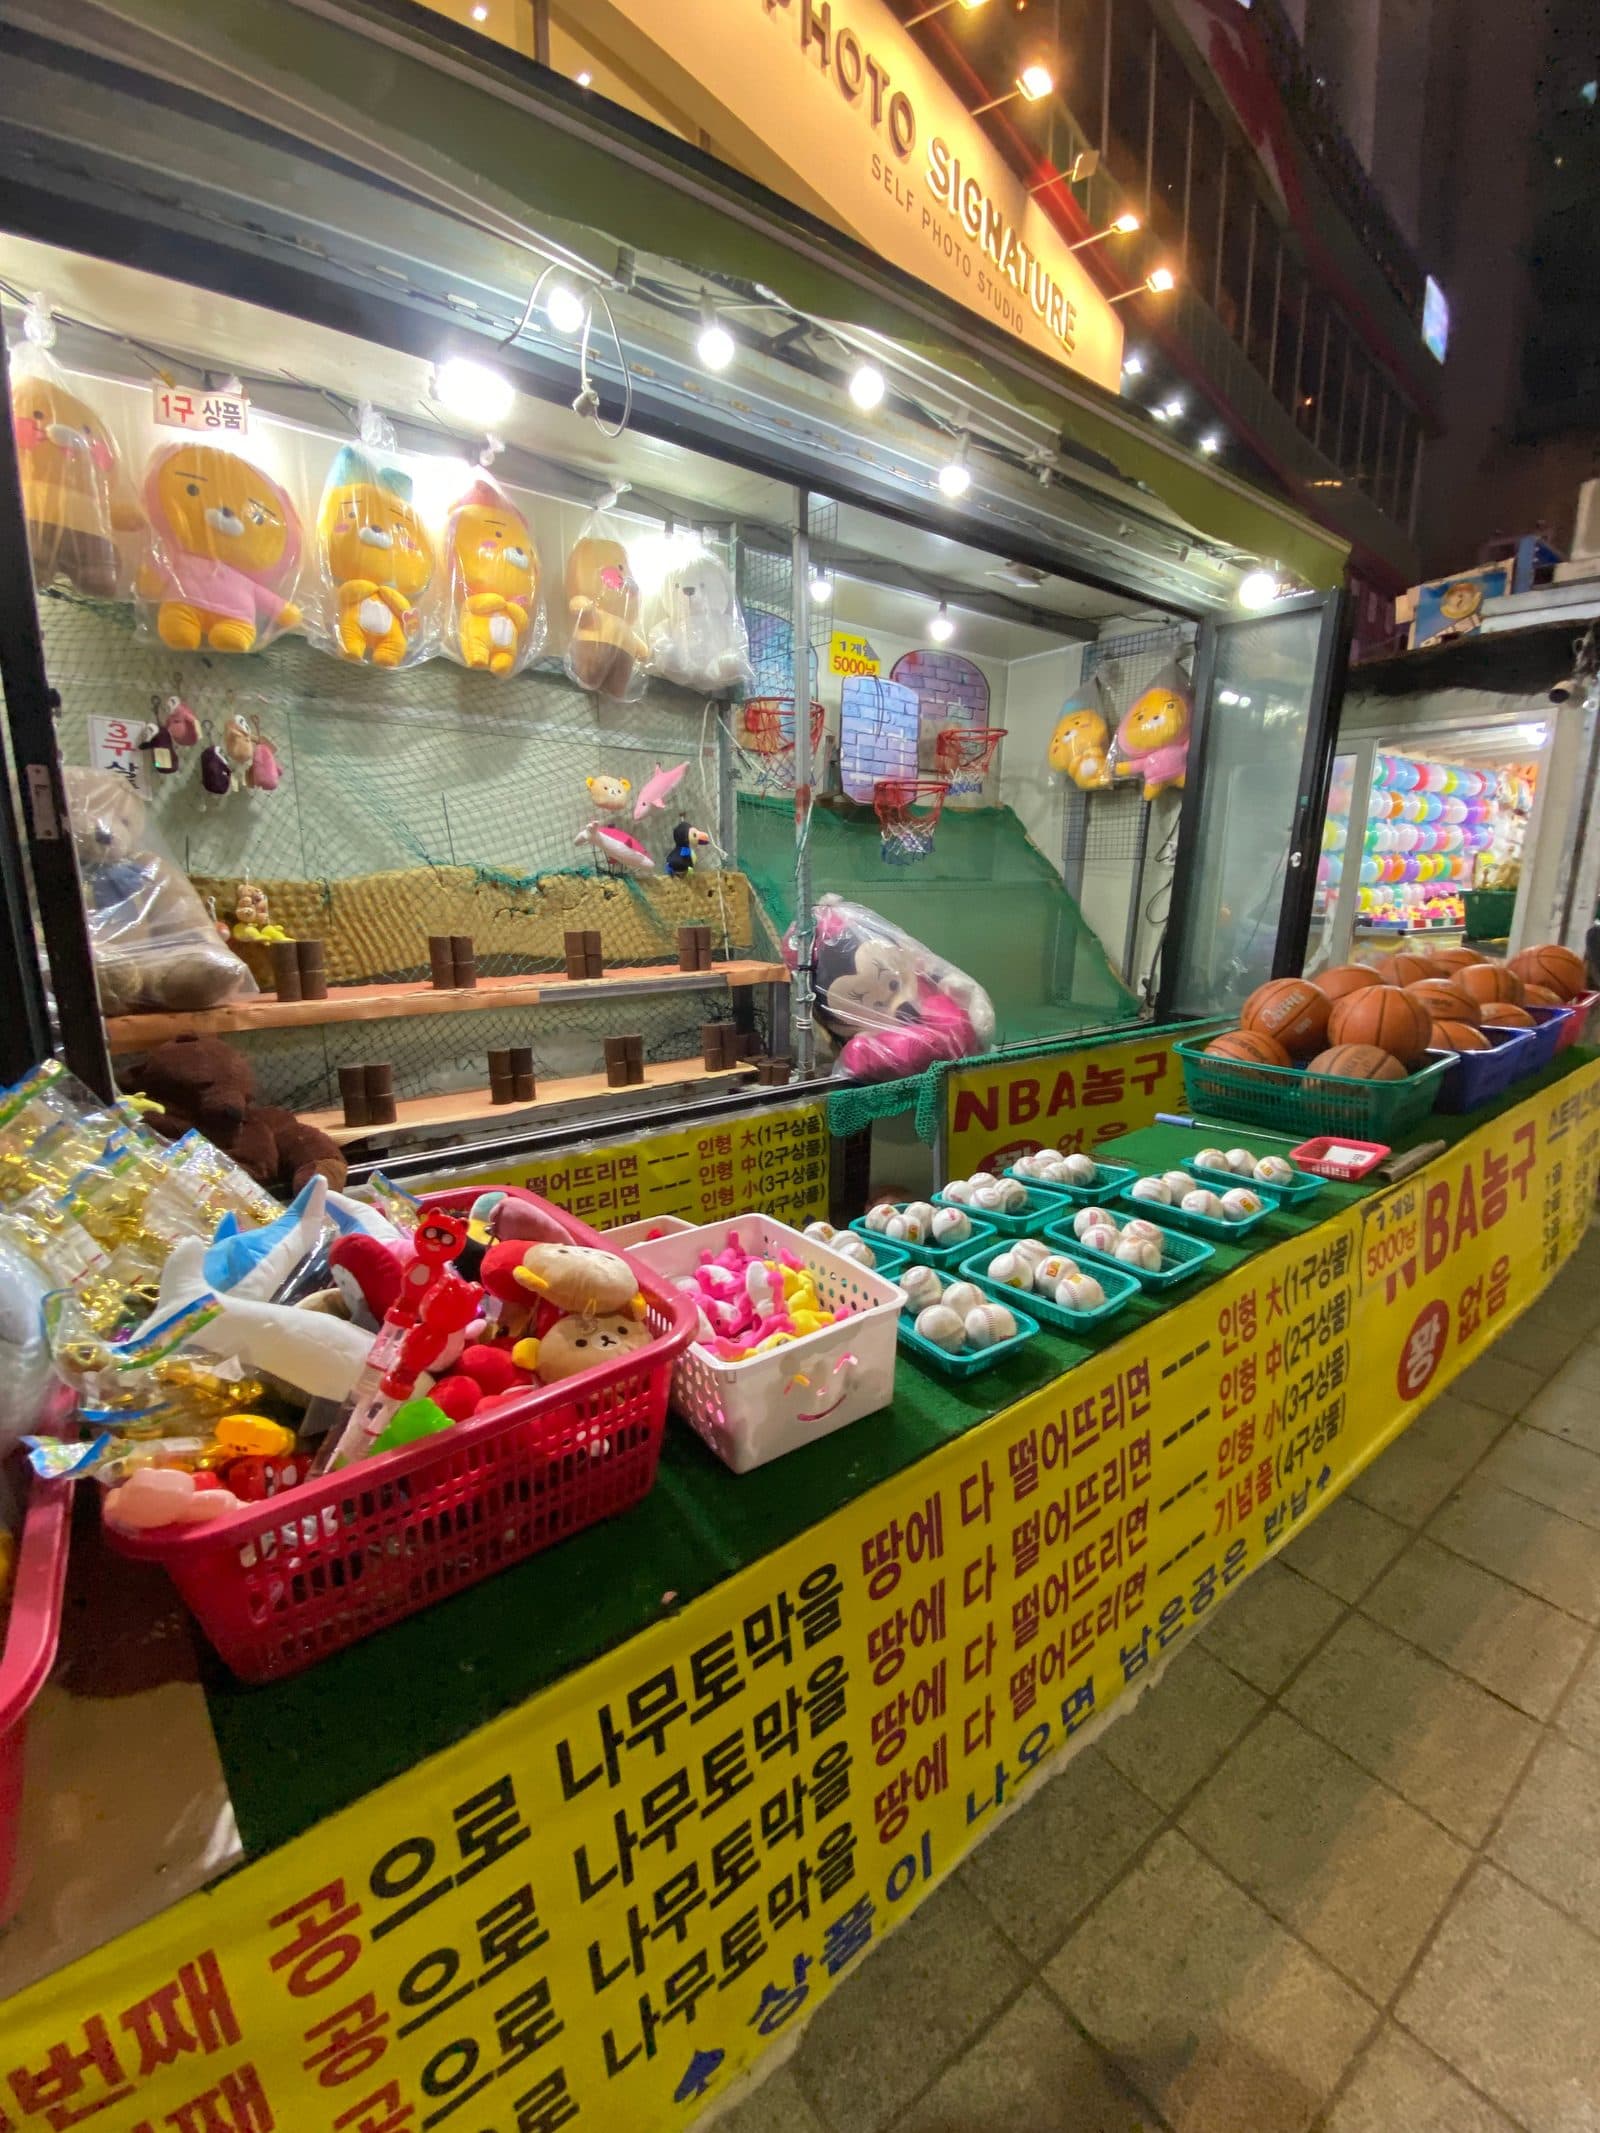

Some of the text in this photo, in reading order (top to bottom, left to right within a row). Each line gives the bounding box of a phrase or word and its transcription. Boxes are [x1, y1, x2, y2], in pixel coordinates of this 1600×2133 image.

[762, 0, 1077, 353] HOTO SIGNATURE
[871, 154, 1024, 334] SELF PHOTO STUDIO
[161, 394, 242, 430] 1구 상품
[697, 1133, 732, 1161] 인형
[953, 1051, 1168, 1133] NBA농구
[555, 1183, 641, 1218] 어뜨리면
[699, 1159, 733, 1187] 인형
[701, 1185, 735, 1213] 인형
[0, 1948, 243, 2133] 번째
[555, 1562, 845, 1802] 나무토막을
[861, 1489, 945, 1601] 땅에
[959, 1460, 995, 1527] 다
[1008, 1357, 1151, 1503] 떨어뜨리면
[1217, 1287, 1257, 1358] 인형
[573, 1655, 850, 1904] 나무토막을
[866, 1575, 947, 1687] 땅에
[963, 1543, 997, 1609] 다
[1011, 1429, 1153, 1580] 떨어뜨리면
[1218, 1351, 1257, 1421] 인형
[587, 1740, 854, 1996] 나무토막을
[870, 1657, 947, 1768] 땅에
[963, 1622, 997, 1685] 다
[1011, 1497, 1150, 1653] 떨어뜨리면
[1217, 1413, 1257, 1481] 인형
[601, 1821, 858, 2079] 나무토막을
[873, 1733, 949, 1845] 땅에
[963, 1694, 996, 1760] 다
[1009, 1562, 1149, 1723] 떨어뜨리면
[965, 1674, 1096, 1826] 나오면
